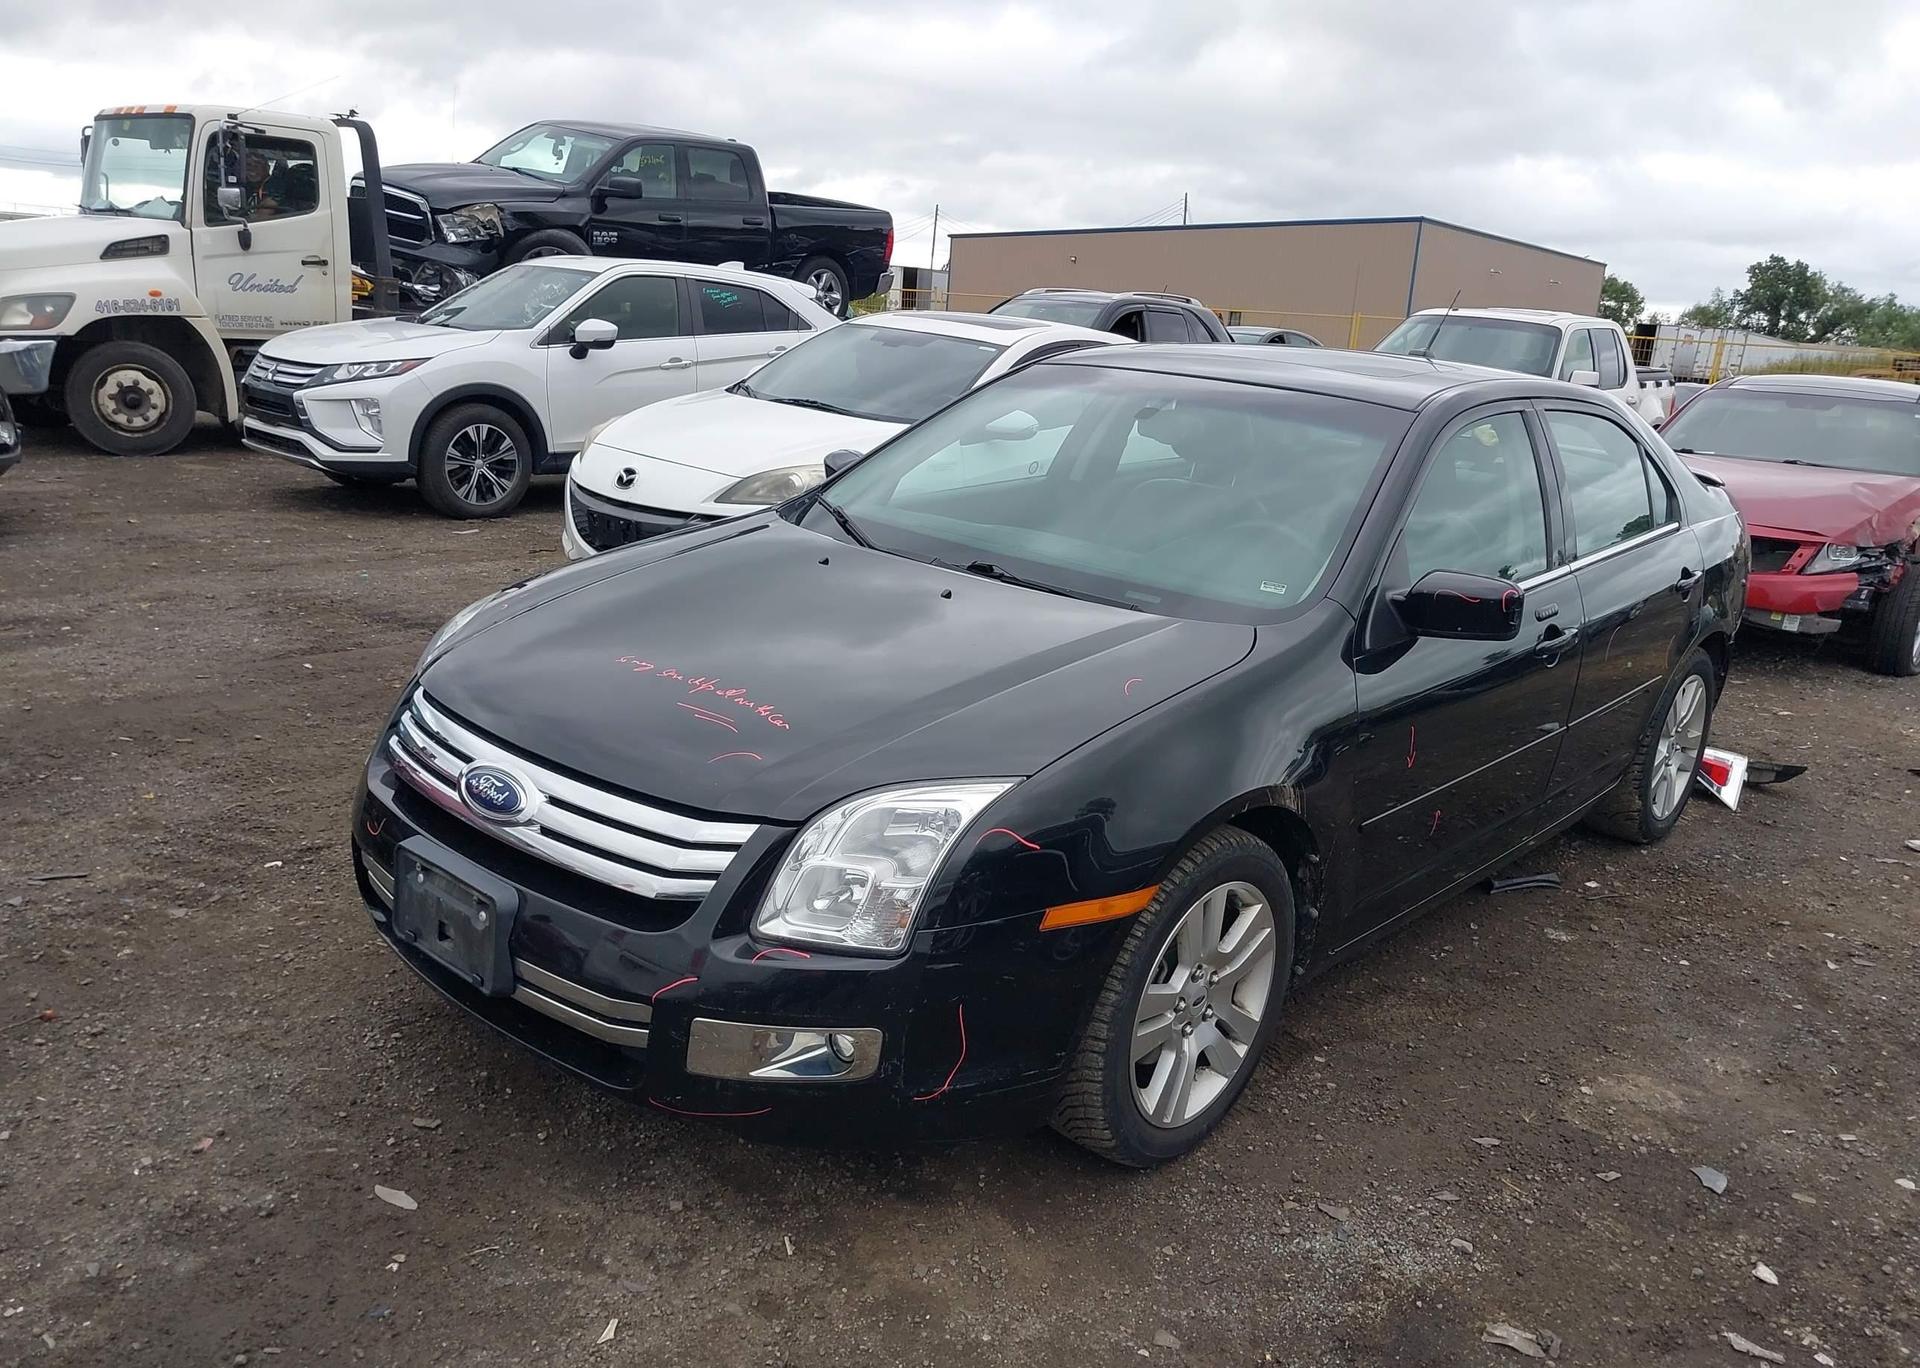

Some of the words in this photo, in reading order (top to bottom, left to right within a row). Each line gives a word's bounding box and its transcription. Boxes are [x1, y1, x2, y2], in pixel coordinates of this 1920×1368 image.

[228, 272, 304, 294] United
[95, 299, 181, 313] 416-524-6161
[214, 314, 239, 323] FLATBED
[240, 314, 262, 323] SERVICE
[469, 775, 510, 806] Ford
